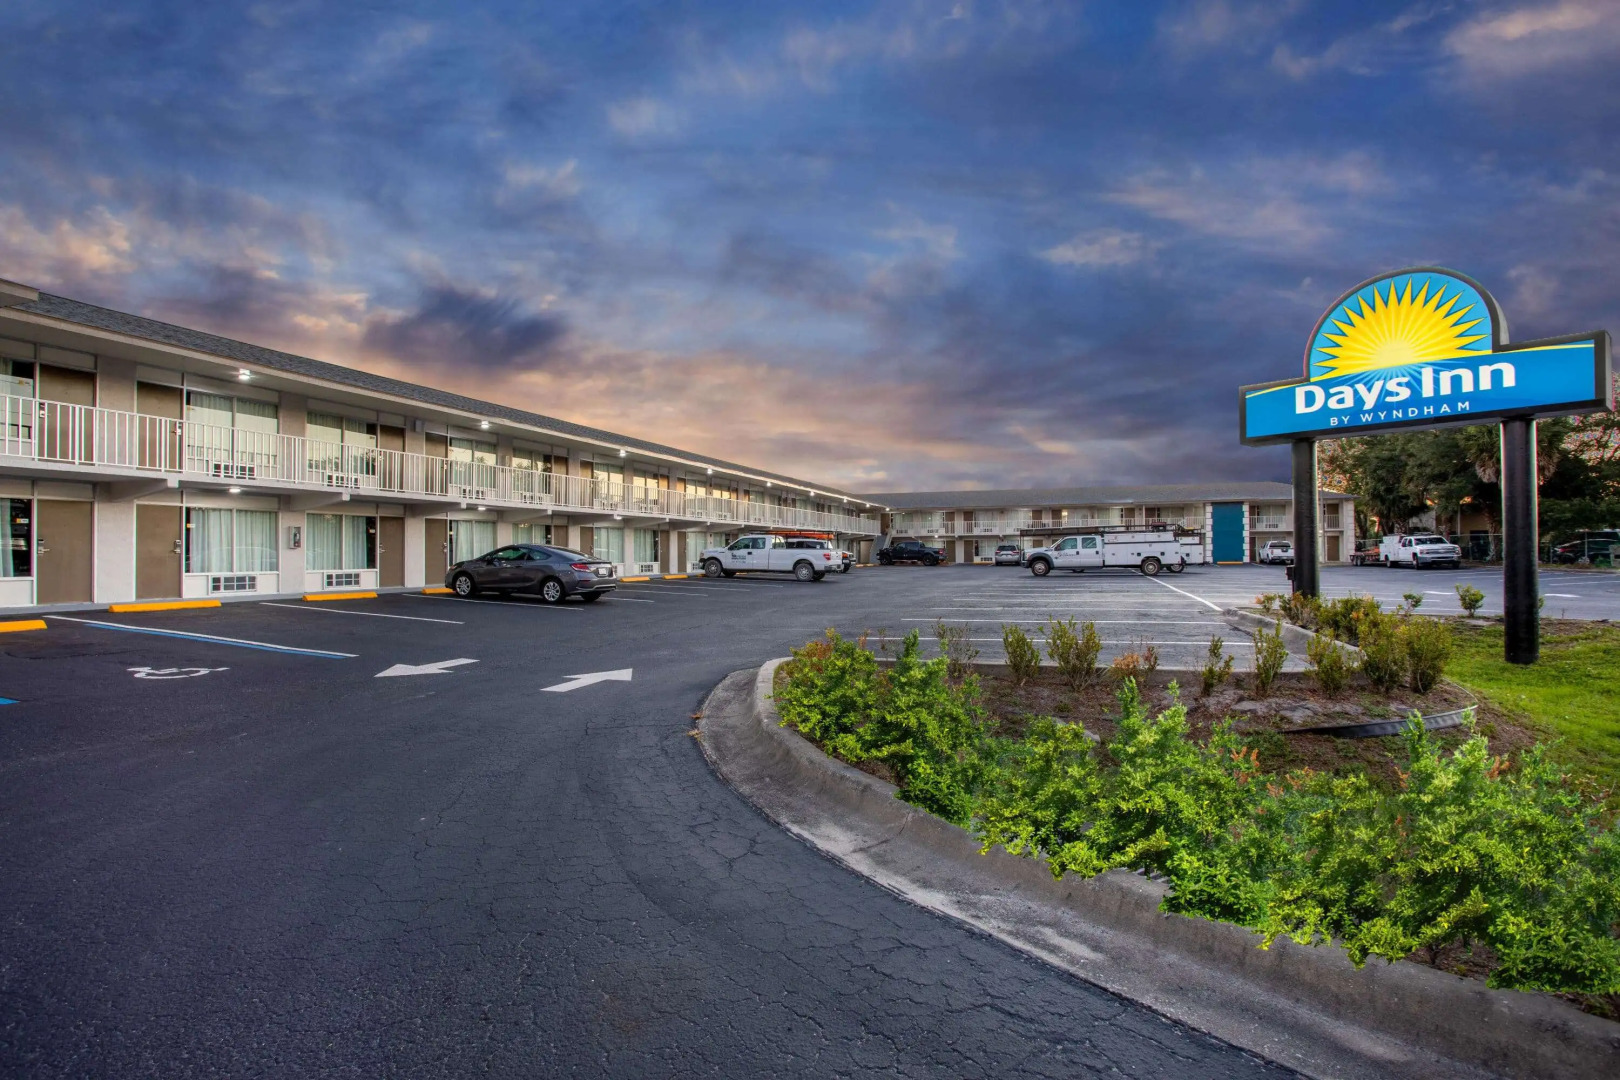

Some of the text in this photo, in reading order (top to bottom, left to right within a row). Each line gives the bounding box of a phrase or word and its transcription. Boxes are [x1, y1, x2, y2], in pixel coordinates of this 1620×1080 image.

[1295, 362, 1516, 414] Days Inn
[1330, 401, 1470, 426] BY WYNDHAM
